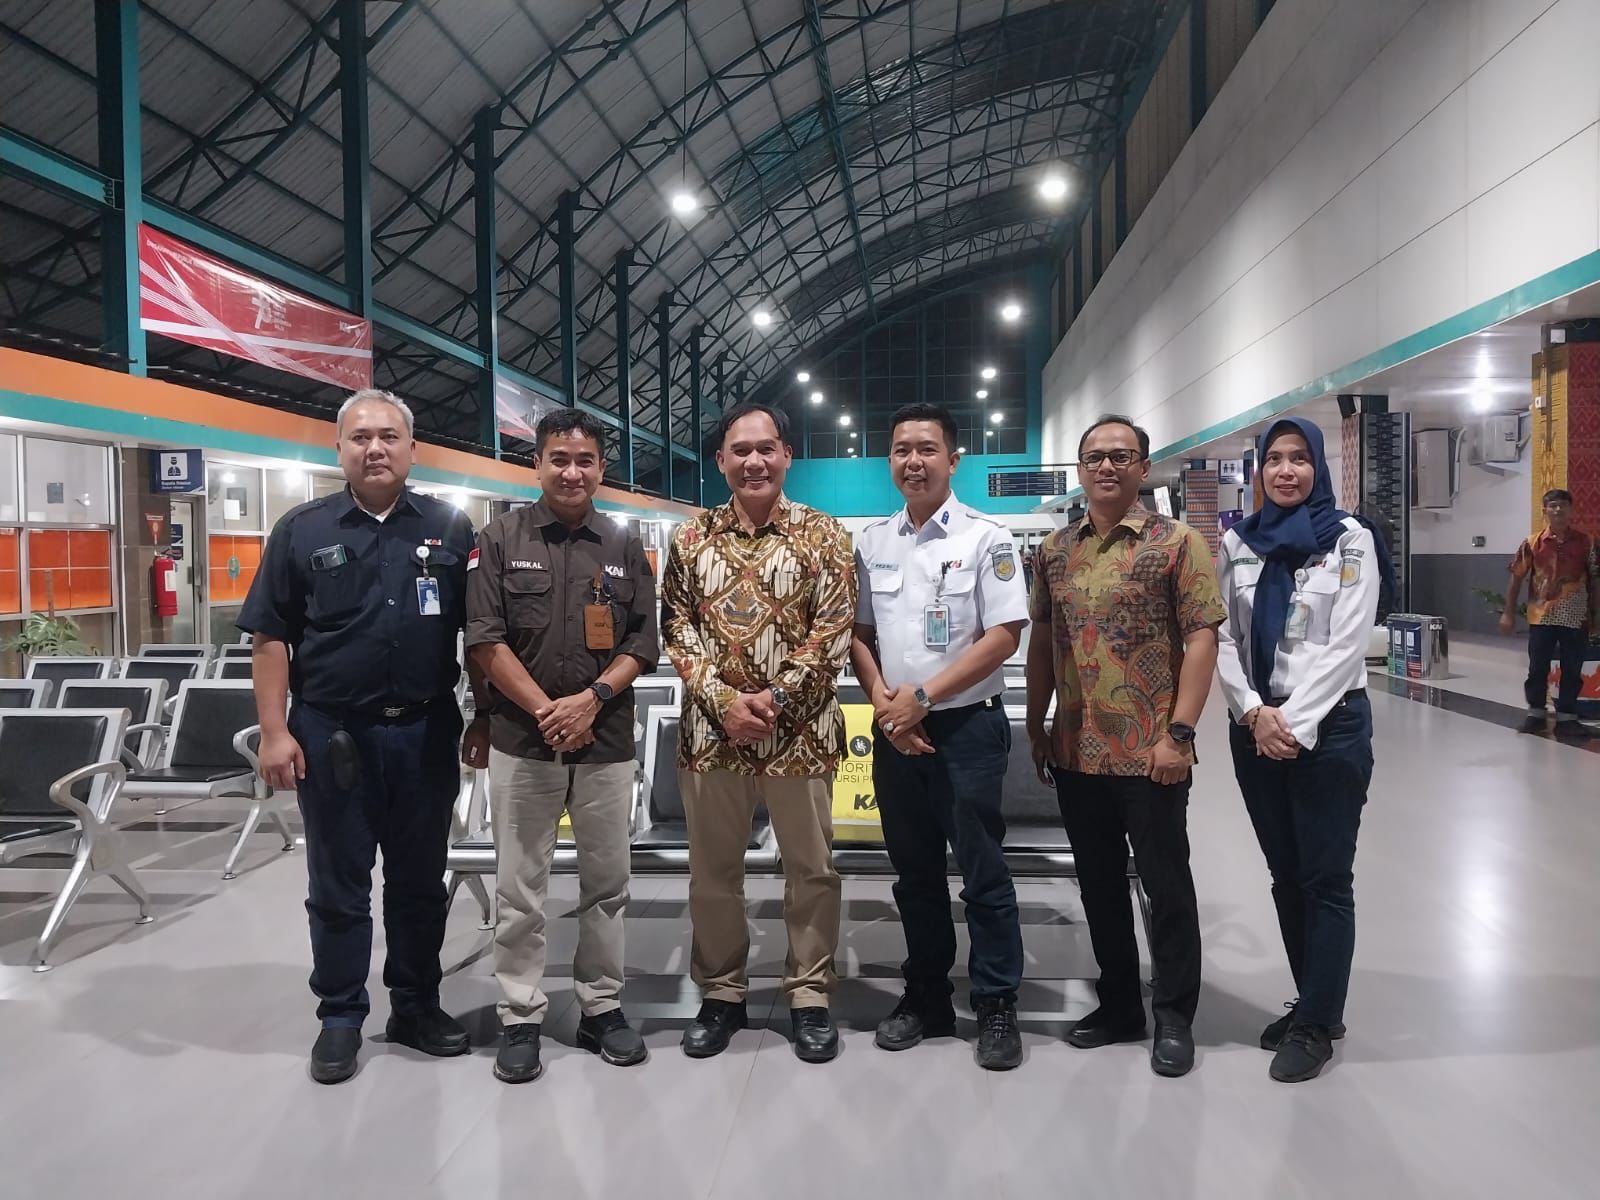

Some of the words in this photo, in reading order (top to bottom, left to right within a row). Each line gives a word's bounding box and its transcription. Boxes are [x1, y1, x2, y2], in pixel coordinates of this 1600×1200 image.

[511, 560, 543, 569] YUSKAL
[604, 564, 624, 577] KAI
[835, 774, 860, 784] URSI
[853, 794, 878, 811] KA
